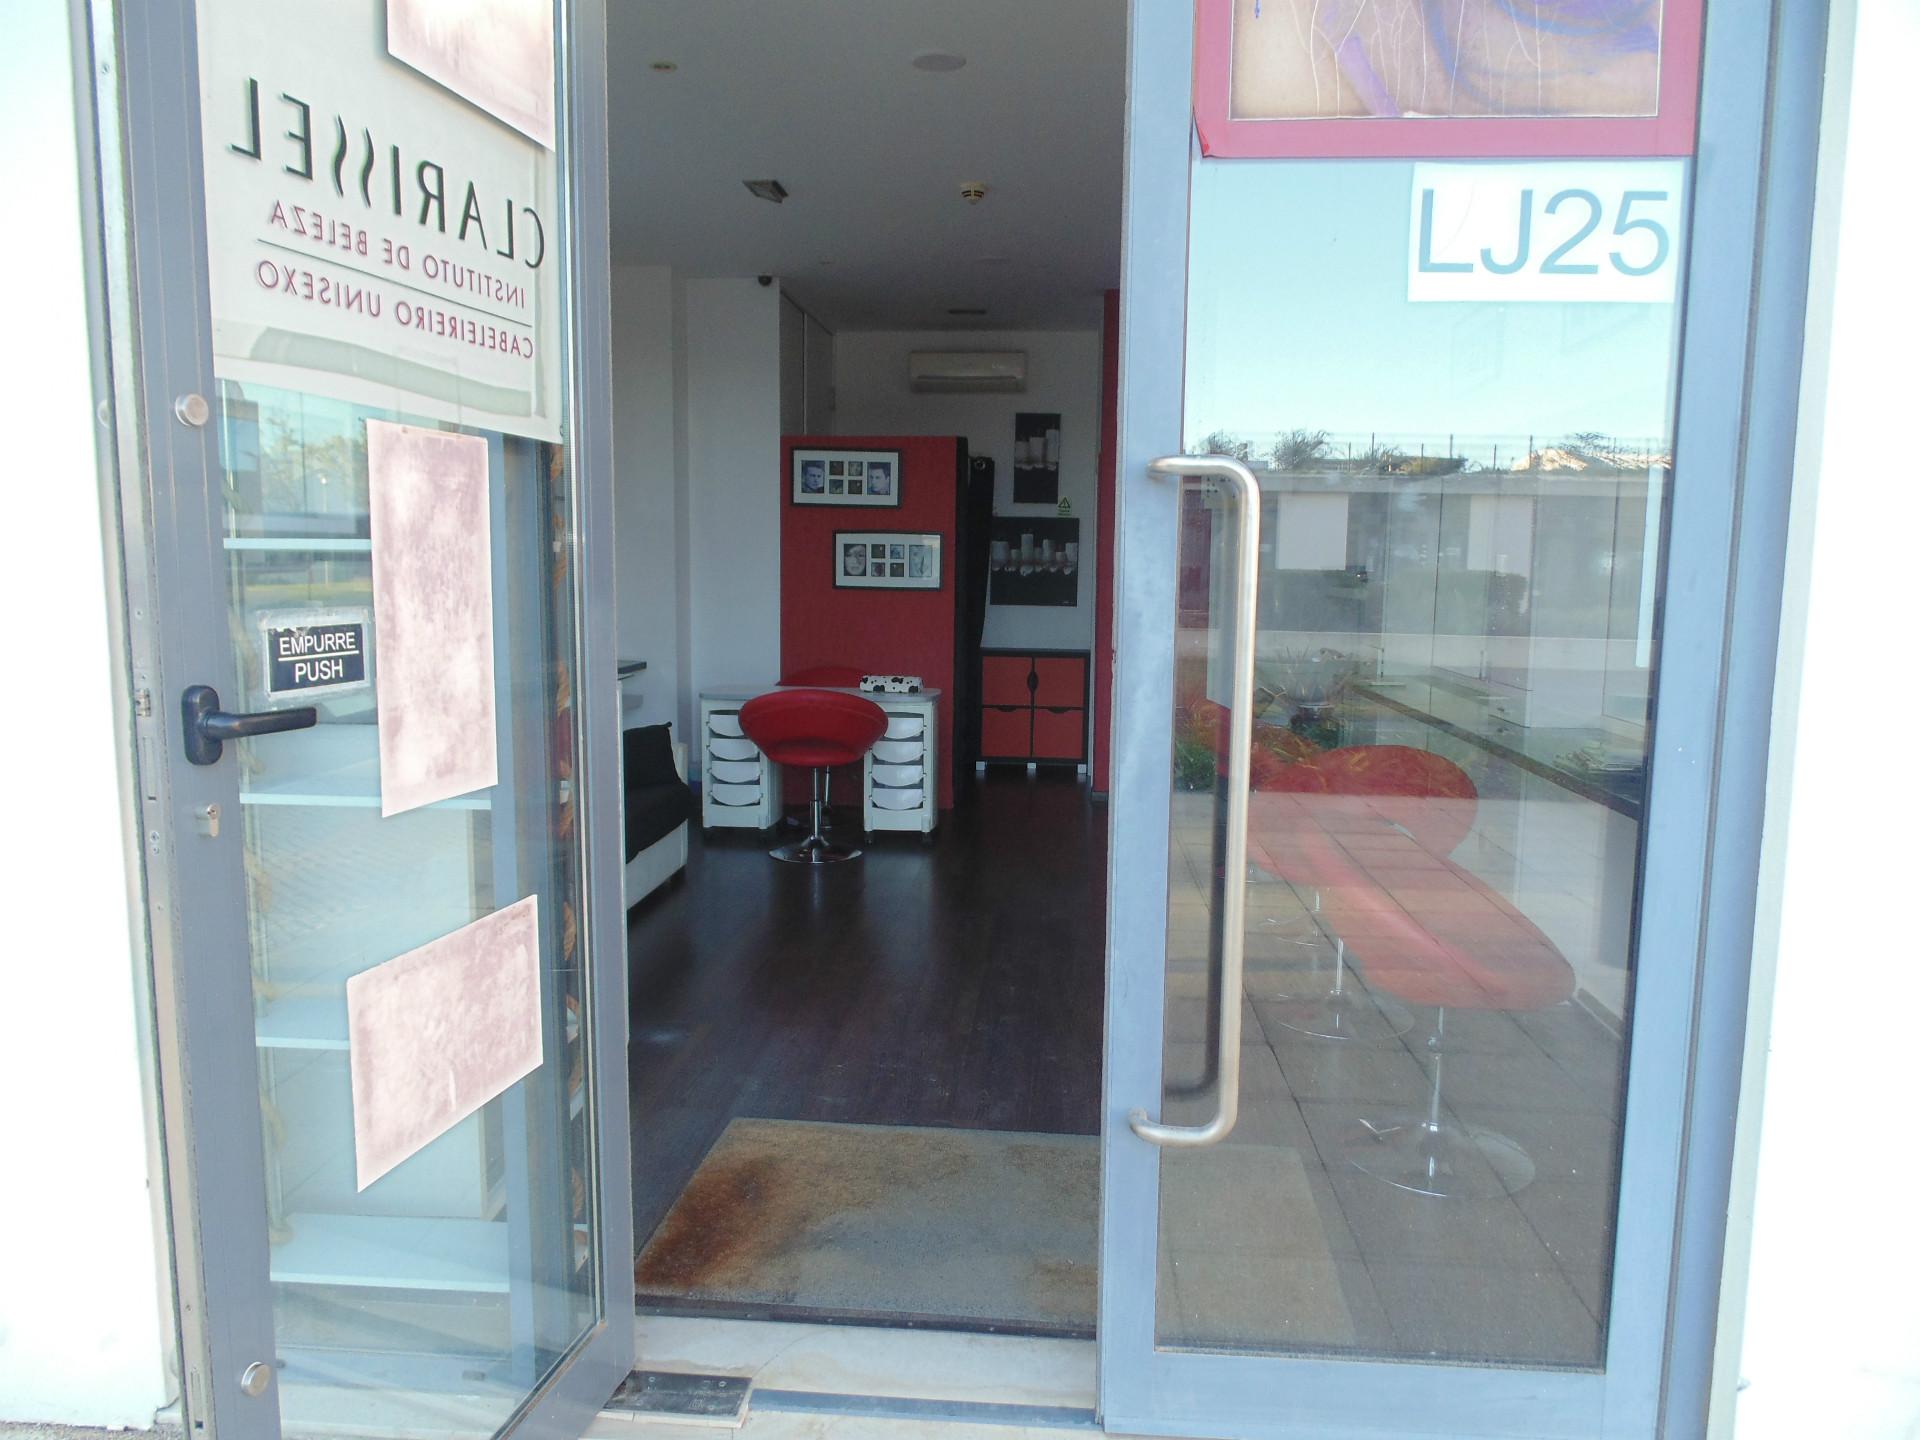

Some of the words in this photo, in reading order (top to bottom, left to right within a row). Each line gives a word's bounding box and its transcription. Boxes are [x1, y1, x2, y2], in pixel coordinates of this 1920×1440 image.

[1418, 188, 1669, 276] LJ25
[280, 632, 355, 655] EMPURRE
[295, 659, 343, 683] PUSH
